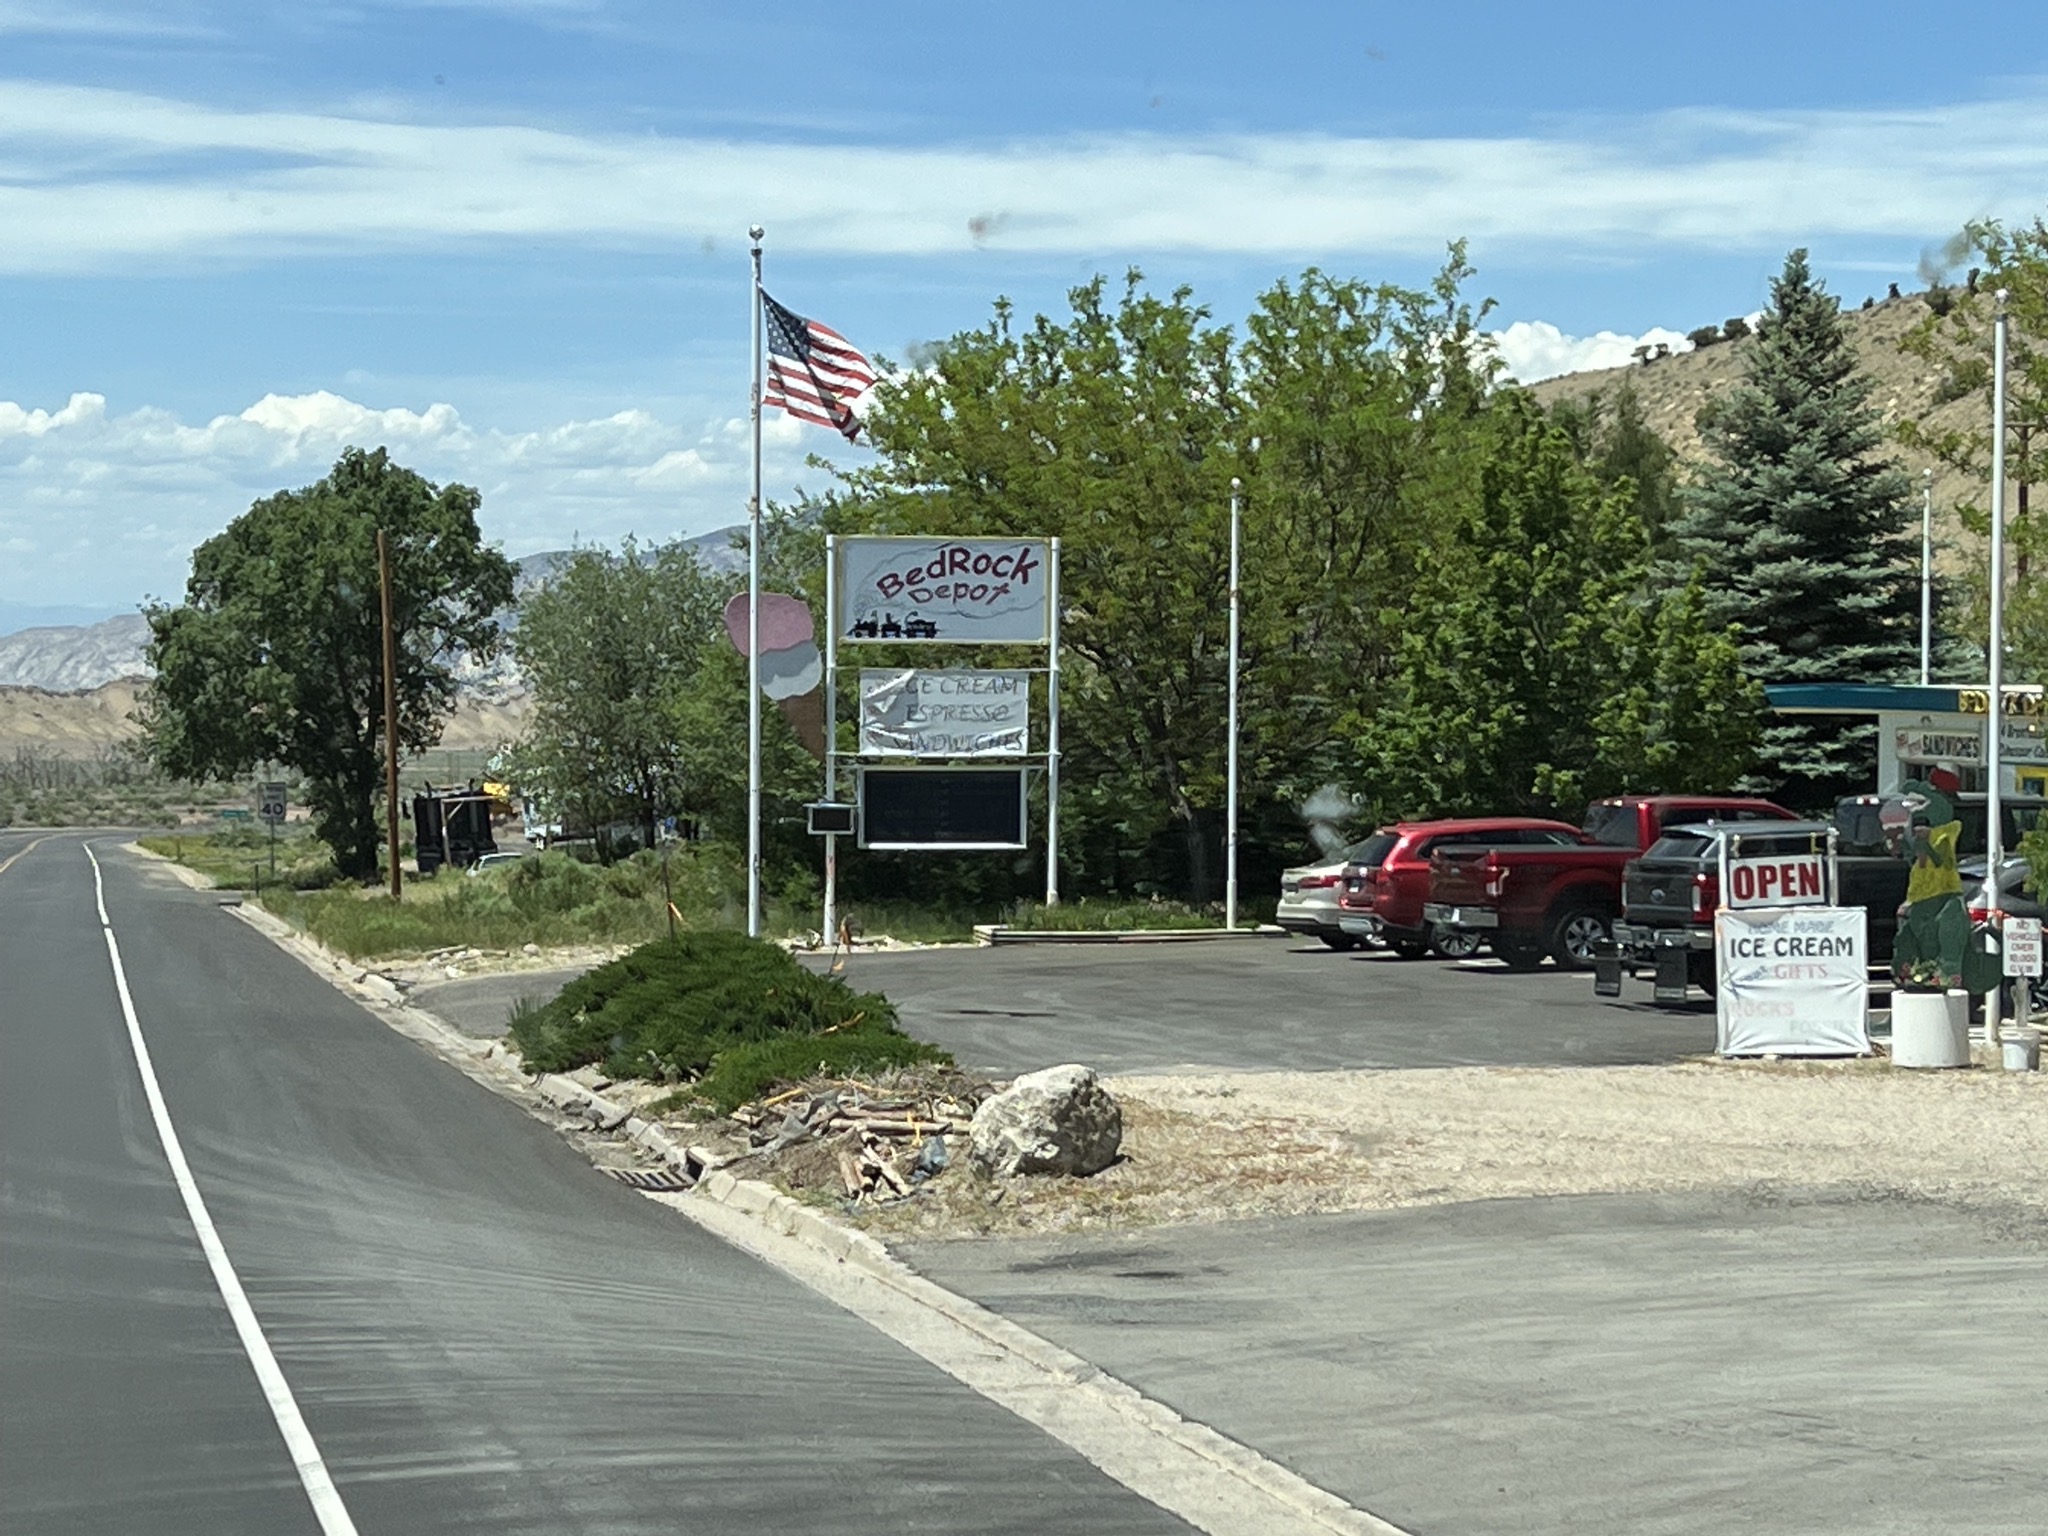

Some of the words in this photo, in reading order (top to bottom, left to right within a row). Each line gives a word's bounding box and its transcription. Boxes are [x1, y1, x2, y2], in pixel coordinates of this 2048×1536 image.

[907, 582, 1010, 605] Depot
[901, 676, 933, 694] CE
[940, 677, 1018, 695] CREAM
[261, 803, 283, 815] 40
[1733, 862, 1820, 900] OPEN
[1730, 937, 1766, 958] ICE
[1773, 936, 1854, 957] CREAM
[1773, 963, 1829, 979] GIFTS
